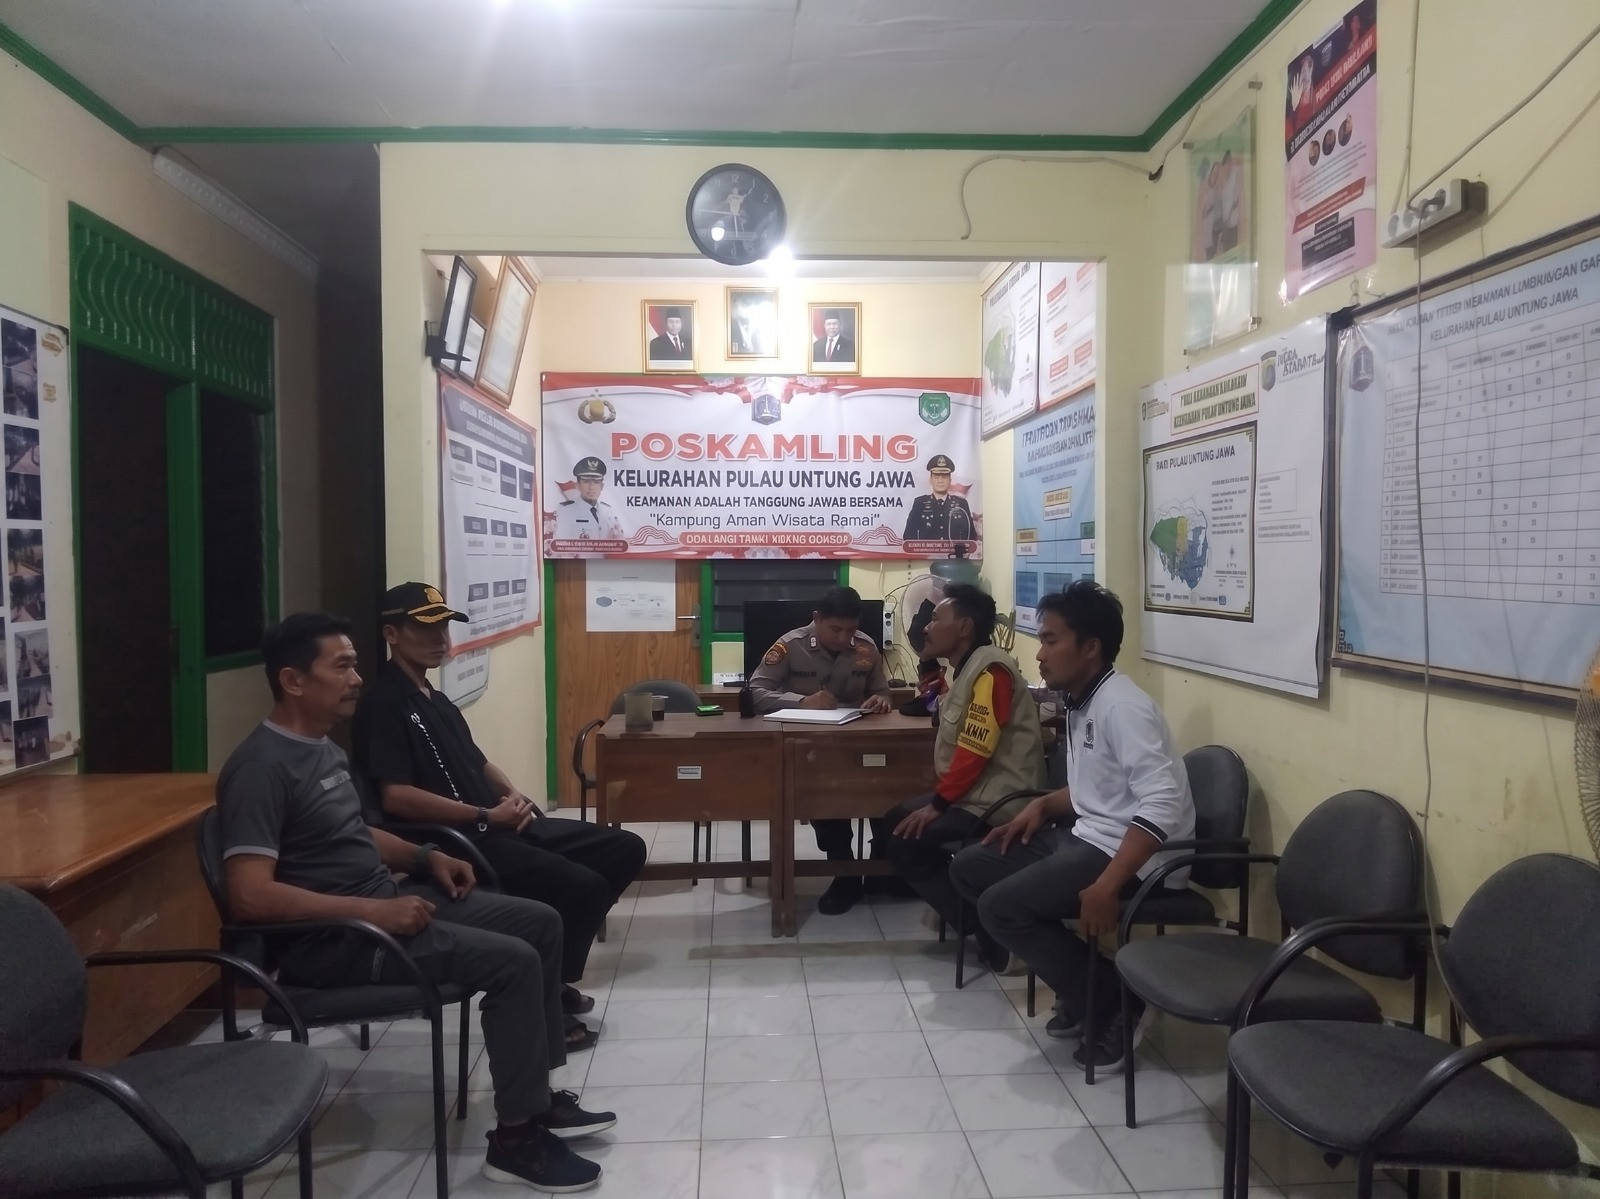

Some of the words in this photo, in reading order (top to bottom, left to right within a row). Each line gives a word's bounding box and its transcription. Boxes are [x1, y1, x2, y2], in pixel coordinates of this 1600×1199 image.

[1430, 319, 1475, 342] KELURAHAN
[1508, 297, 1548, 322] UNTUNG
[1549, 288, 1579, 308] JAWA
[610, 432, 918, 461] POSKAMLING
[1169, 455, 1188, 469] PULAU
[1188, 449, 1214, 465] UNTUNG
[1215, 445, 1236, 459] JAWA
[613, 469, 721, 488] KELURAHAN
[726, 470, 784, 488] PULAU
[789, 470, 861, 489] UNTUNG
[866, 470, 916, 489] JAWA
[626, 495, 692, 508] KEAMANAN
[694, 496, 741, 508] ADALAH
[743, 496, 806, 508] TANGGUNG
[808, 496, 847, 508] JAWAB
[849, 496, 904, 508] BERSAMA
[649, 513, 721, 529] "Kampung
[726, 514, 766, 527] Aman
[771, 513, 825, 527] Wisata
[831, 513, 880, 527] Ramai"
